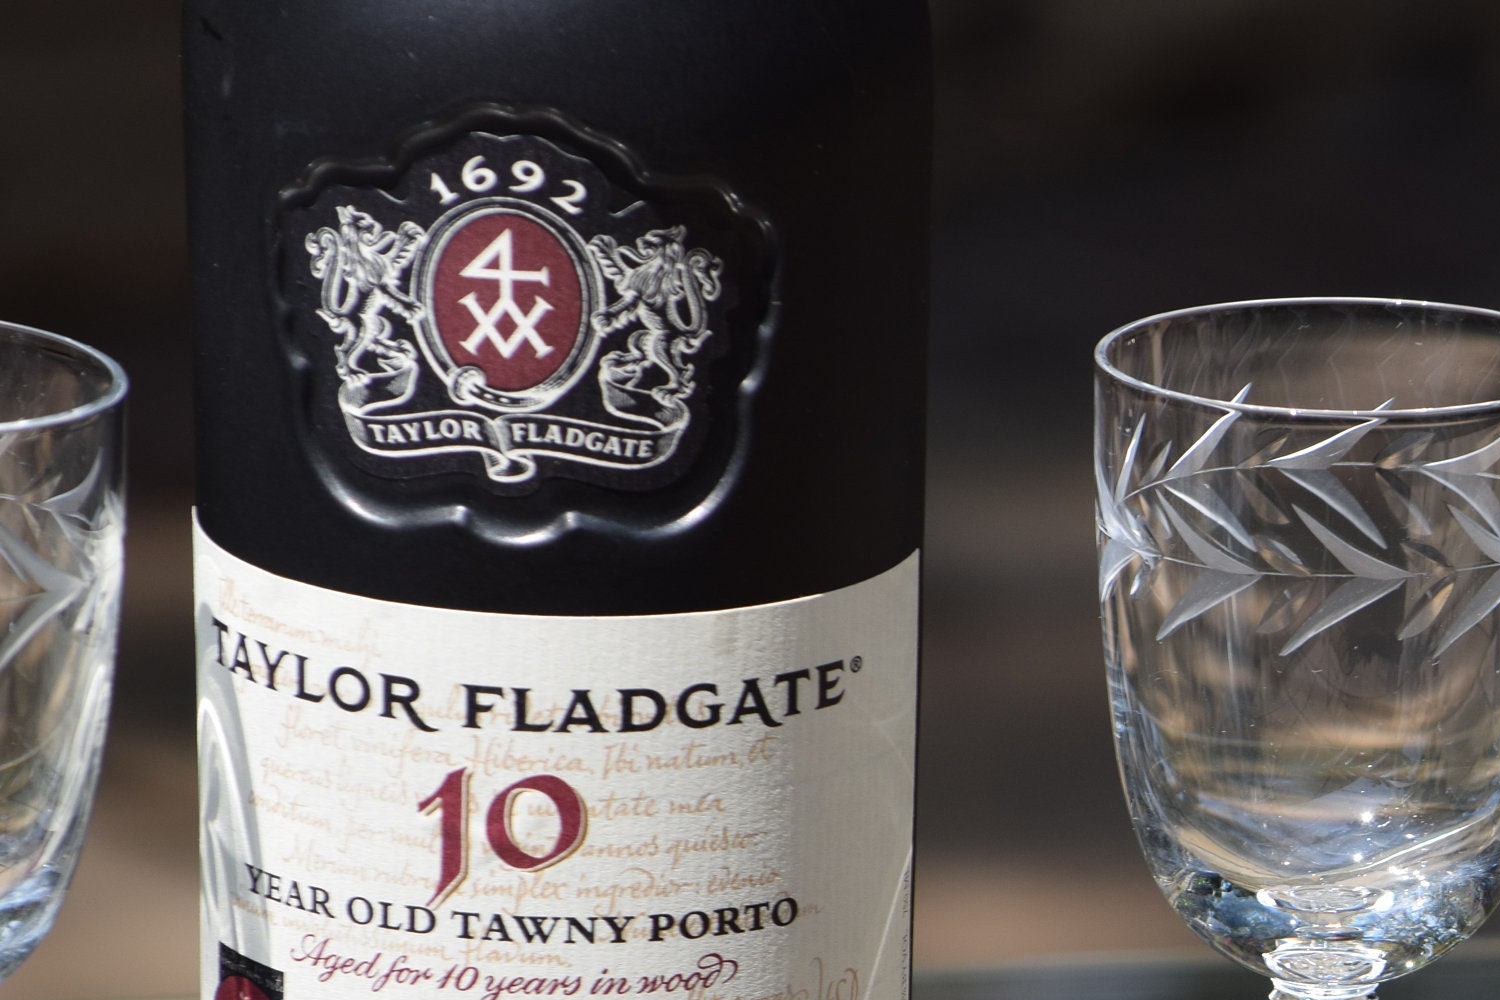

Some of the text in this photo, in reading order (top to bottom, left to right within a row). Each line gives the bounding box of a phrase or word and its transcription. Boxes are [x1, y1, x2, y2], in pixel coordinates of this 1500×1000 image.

[430, 155, 588, 214] 1692
[367, 418, 654, 459] TAYLOR FLADGATE
[212, 616, 439, 732] TAYLOR
[418, 767, 588, 908] 10
[245, 863, 336, 919] YEAR
[347, 896, 436, 934] OLD
[450, 910, 635, 944] TAWNY
[648, 896, 798, 942] PORTO
[289, 934, 382, 983] Aged
[371, 955, 433, 993] for
[437, 964, 480, 992] 10
[589, 968, 633, 996] in
[637, 953, 739, 995] wood
